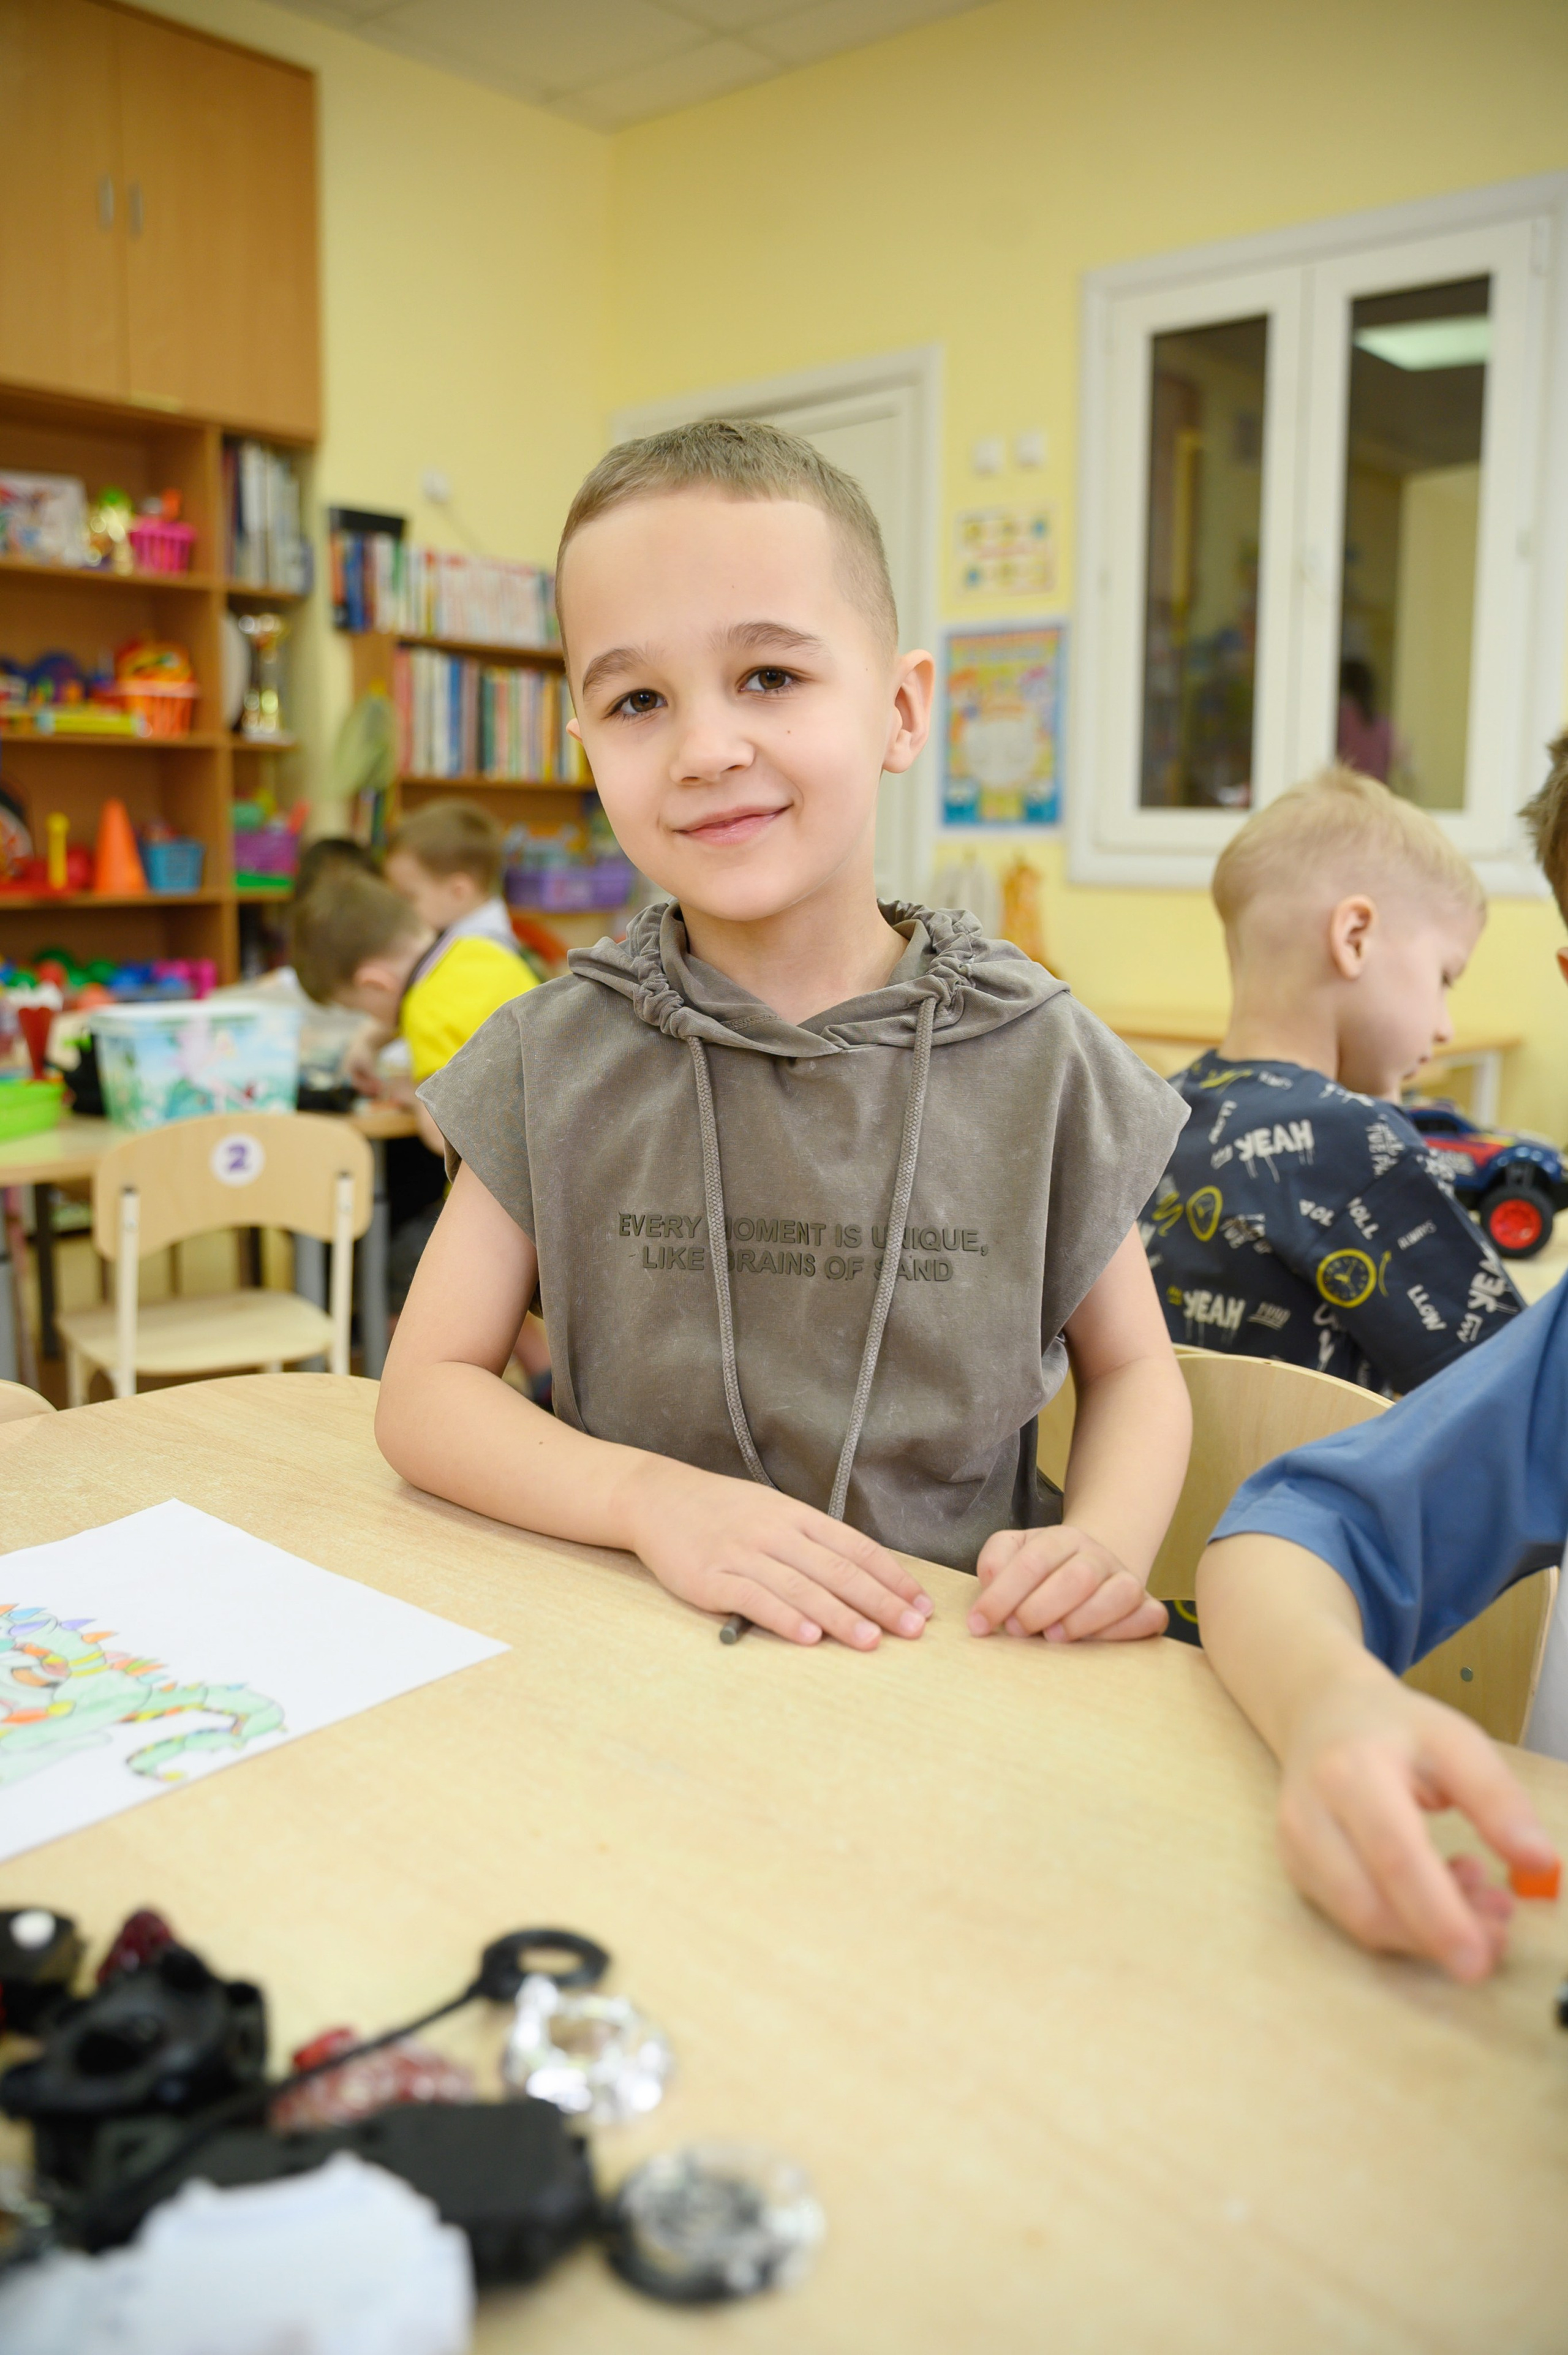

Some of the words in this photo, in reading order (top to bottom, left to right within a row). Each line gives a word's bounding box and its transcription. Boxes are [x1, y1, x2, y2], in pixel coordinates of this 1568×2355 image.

[228, 1143, 248, 1173] 2
[1234, 1119, 1316, 1163] YEAH
[619, 1214, 702, 1239] EVERY
[725, 1217, 827, 1246] OMENT
[835, 1223, 862, 1249] IS
[643, 1246, 704, 1271] LIKE
[824, 1255, 864, 1281] OF
[1183, 1288, 1246, 1331] YEAH
